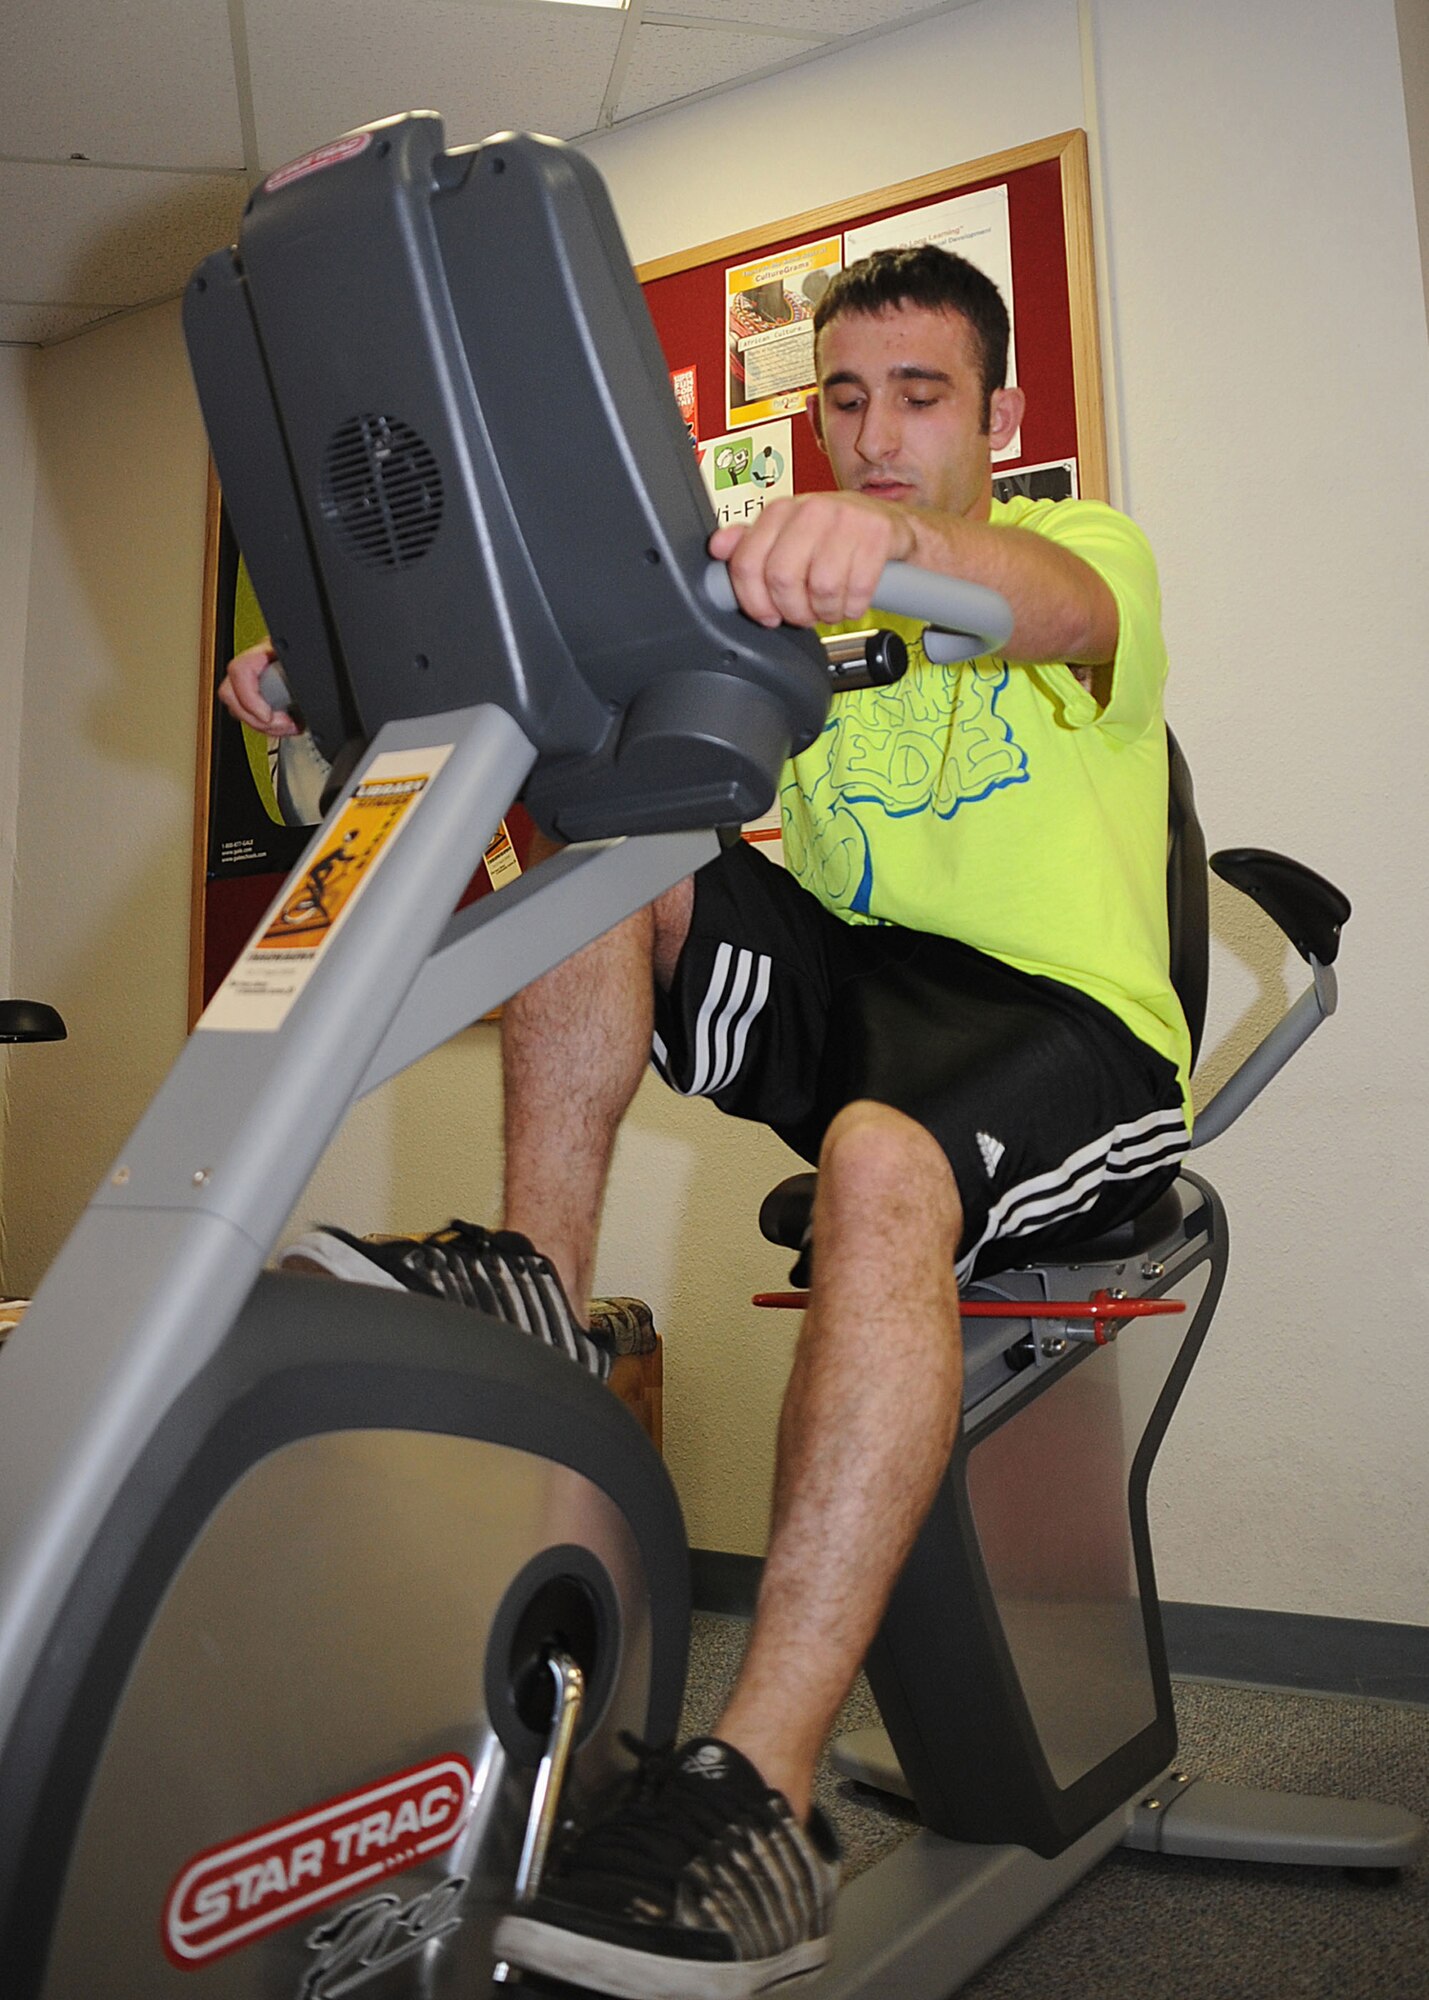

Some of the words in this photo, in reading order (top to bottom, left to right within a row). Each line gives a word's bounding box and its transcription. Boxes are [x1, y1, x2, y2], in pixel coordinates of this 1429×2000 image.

[715, 496, 764, 523] i-Fi
[191, 1838, 327, 1934] STAR
[330, 1784, 455, 1865] TRAC
